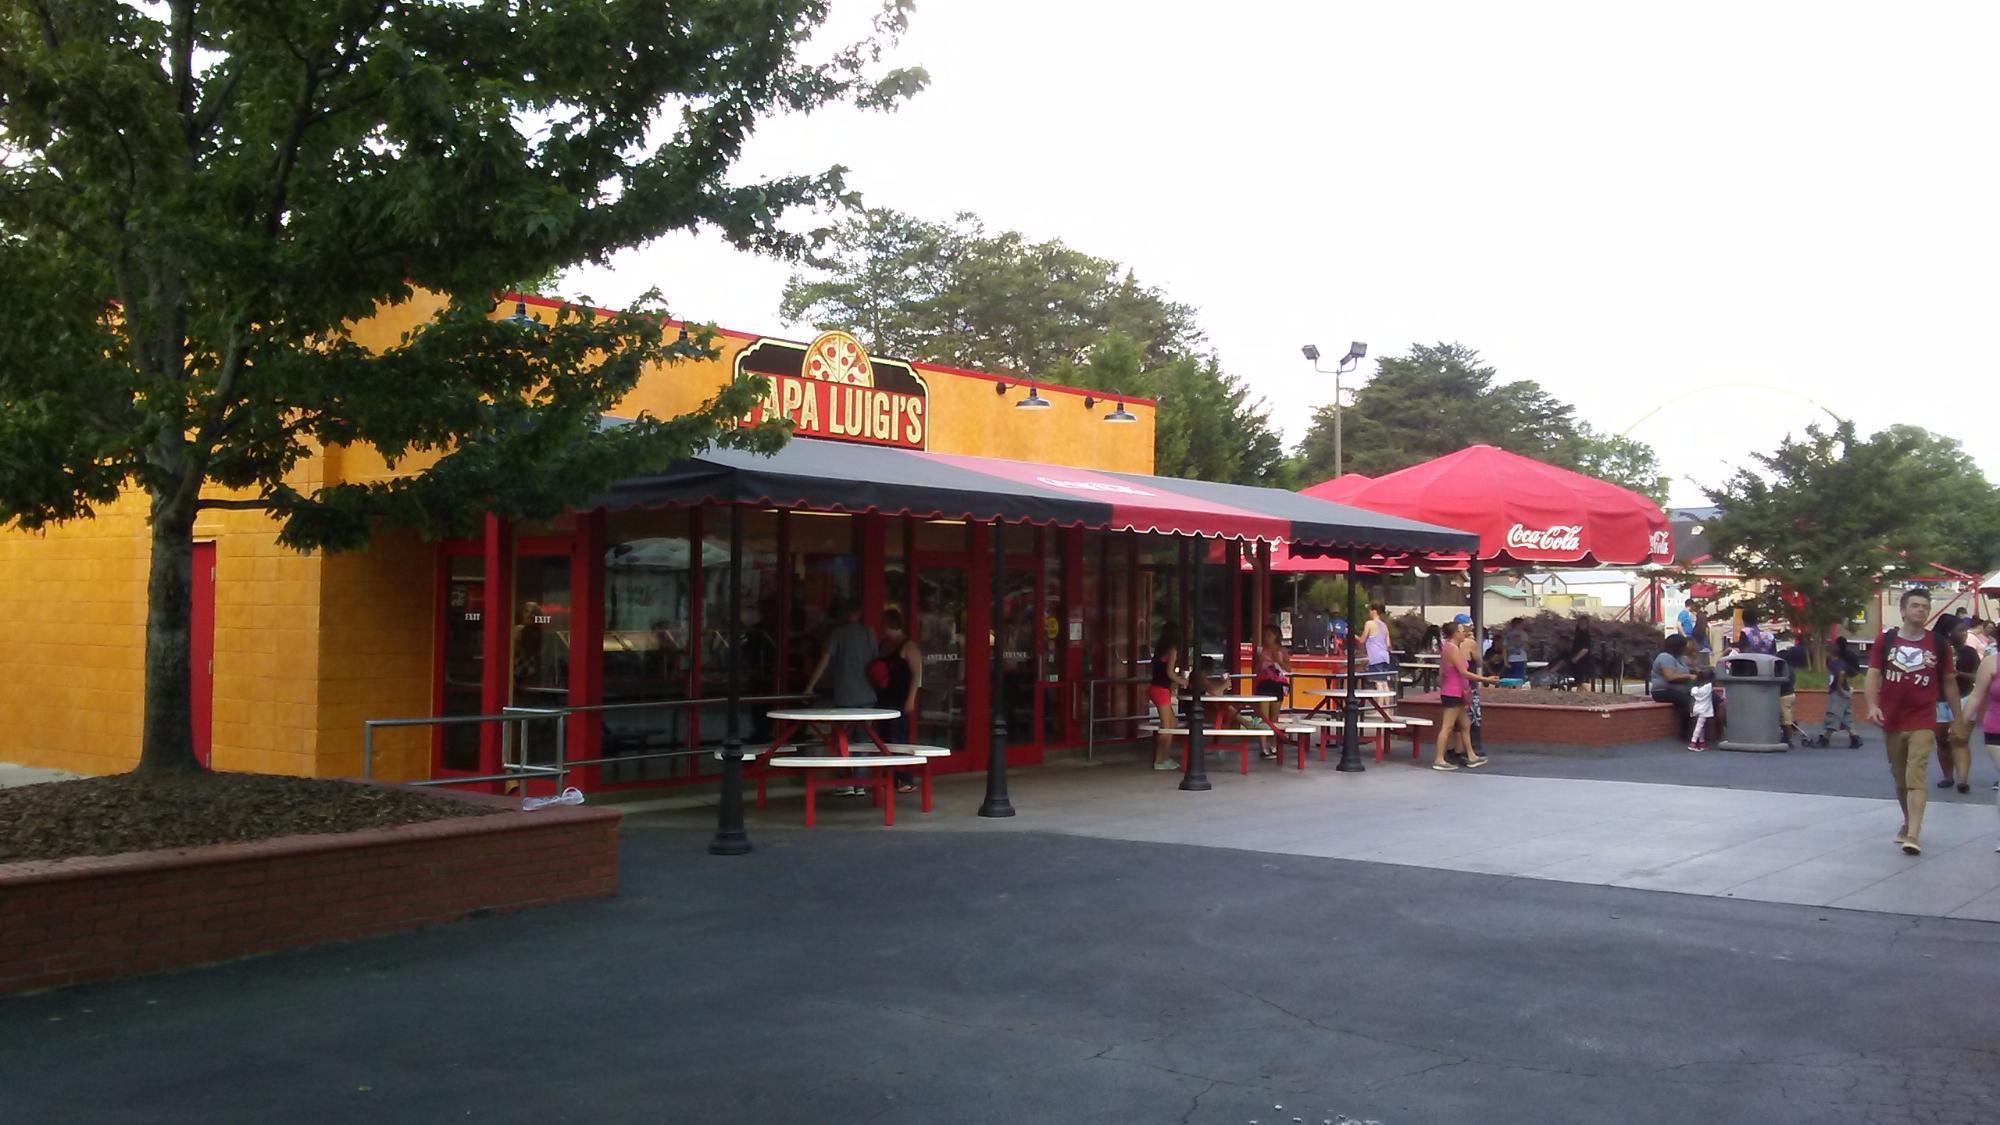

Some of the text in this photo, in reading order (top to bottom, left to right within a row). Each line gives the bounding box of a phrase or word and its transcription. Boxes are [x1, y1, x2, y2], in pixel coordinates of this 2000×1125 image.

[828, 385, 923, 444] LUIGI'S
[1507, 523, 1583, 551] Coca-Cola
[465, 613, 481, 621] EXIT
[534, 615, 552, 624] EXIT
